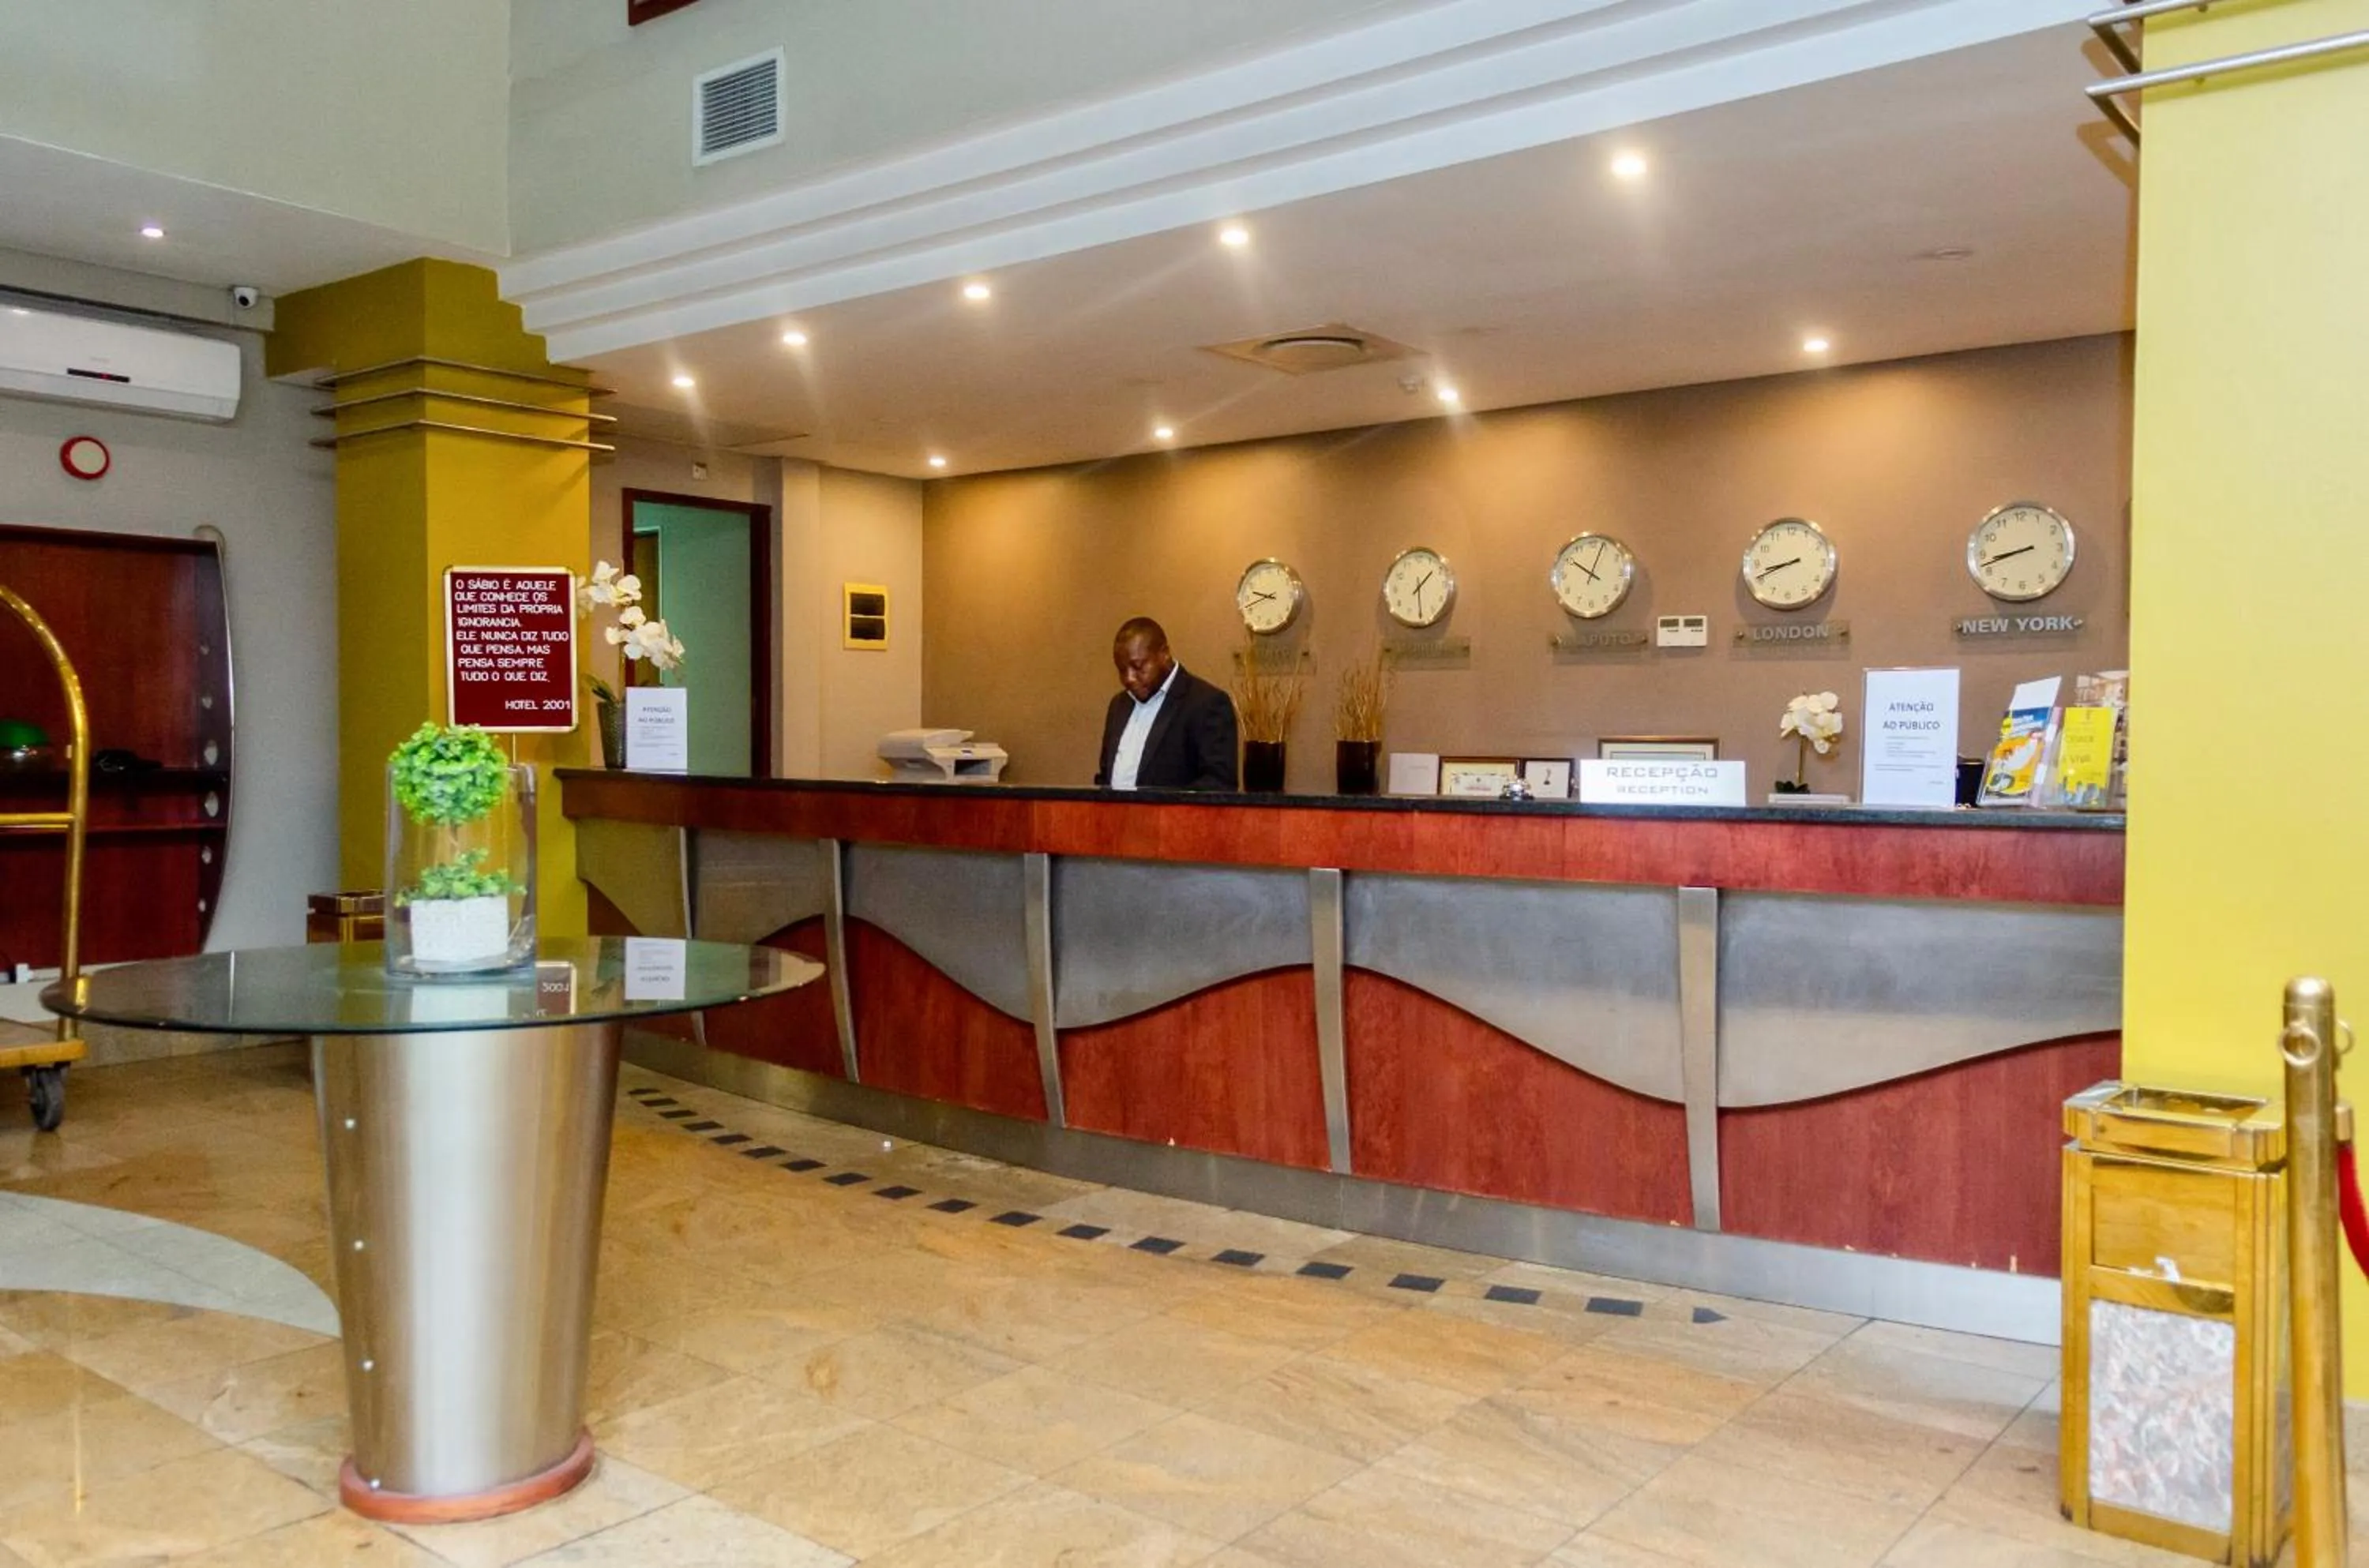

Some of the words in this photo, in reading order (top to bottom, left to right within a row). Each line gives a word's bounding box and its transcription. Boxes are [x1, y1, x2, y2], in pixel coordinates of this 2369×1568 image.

[2014, 511, 2026, 521] 12
[1985, 533, 1996, 542] 10
[456, 579, 465, 590] O
[467, 577, 500, 591] SÁBIO
[503, 578, 512, 591] É
[2000, 577, 2009, 588] 7
[455, 591, 477, 602] QUE
[480, 591, 530, 602] CONHECE
[456, 603, 497, 613] LIMITES
[500, 604, 516, 614] DA
[1963, 618, 2009, 633] NEW
[2017, 616, 2074, 631] YORK
[456, 631, 477, 640] ELE
[480, 631, 518, 641] NUNCA
[520, 631, 538, 641] DIZ
[541, 631, 569, 641] TUDO
[1754, 623, 1830, 640] LONDON
[460, 644, 483, 655] QUE
[527, 644, 550, 655] MAS
[457, 658, 495, 668] PENSA
[497, 658, 544, 668] SEMPRE
[460, 671, 489, 681] TUDO
[491, 671, 500, 681] O
[504, 671, 527, 681] QUE
[505, 700, 539, 710] HOTEL
[543, 700, 571, 710] 2001
[1888, 700, 1934, 714] ATENÇÃO
[1883, 720, 1898, 730] AO
[1606, 763, 1718, 782] RECEPÇÃO
[1616, 785, 1710, 795] RECEPTION
